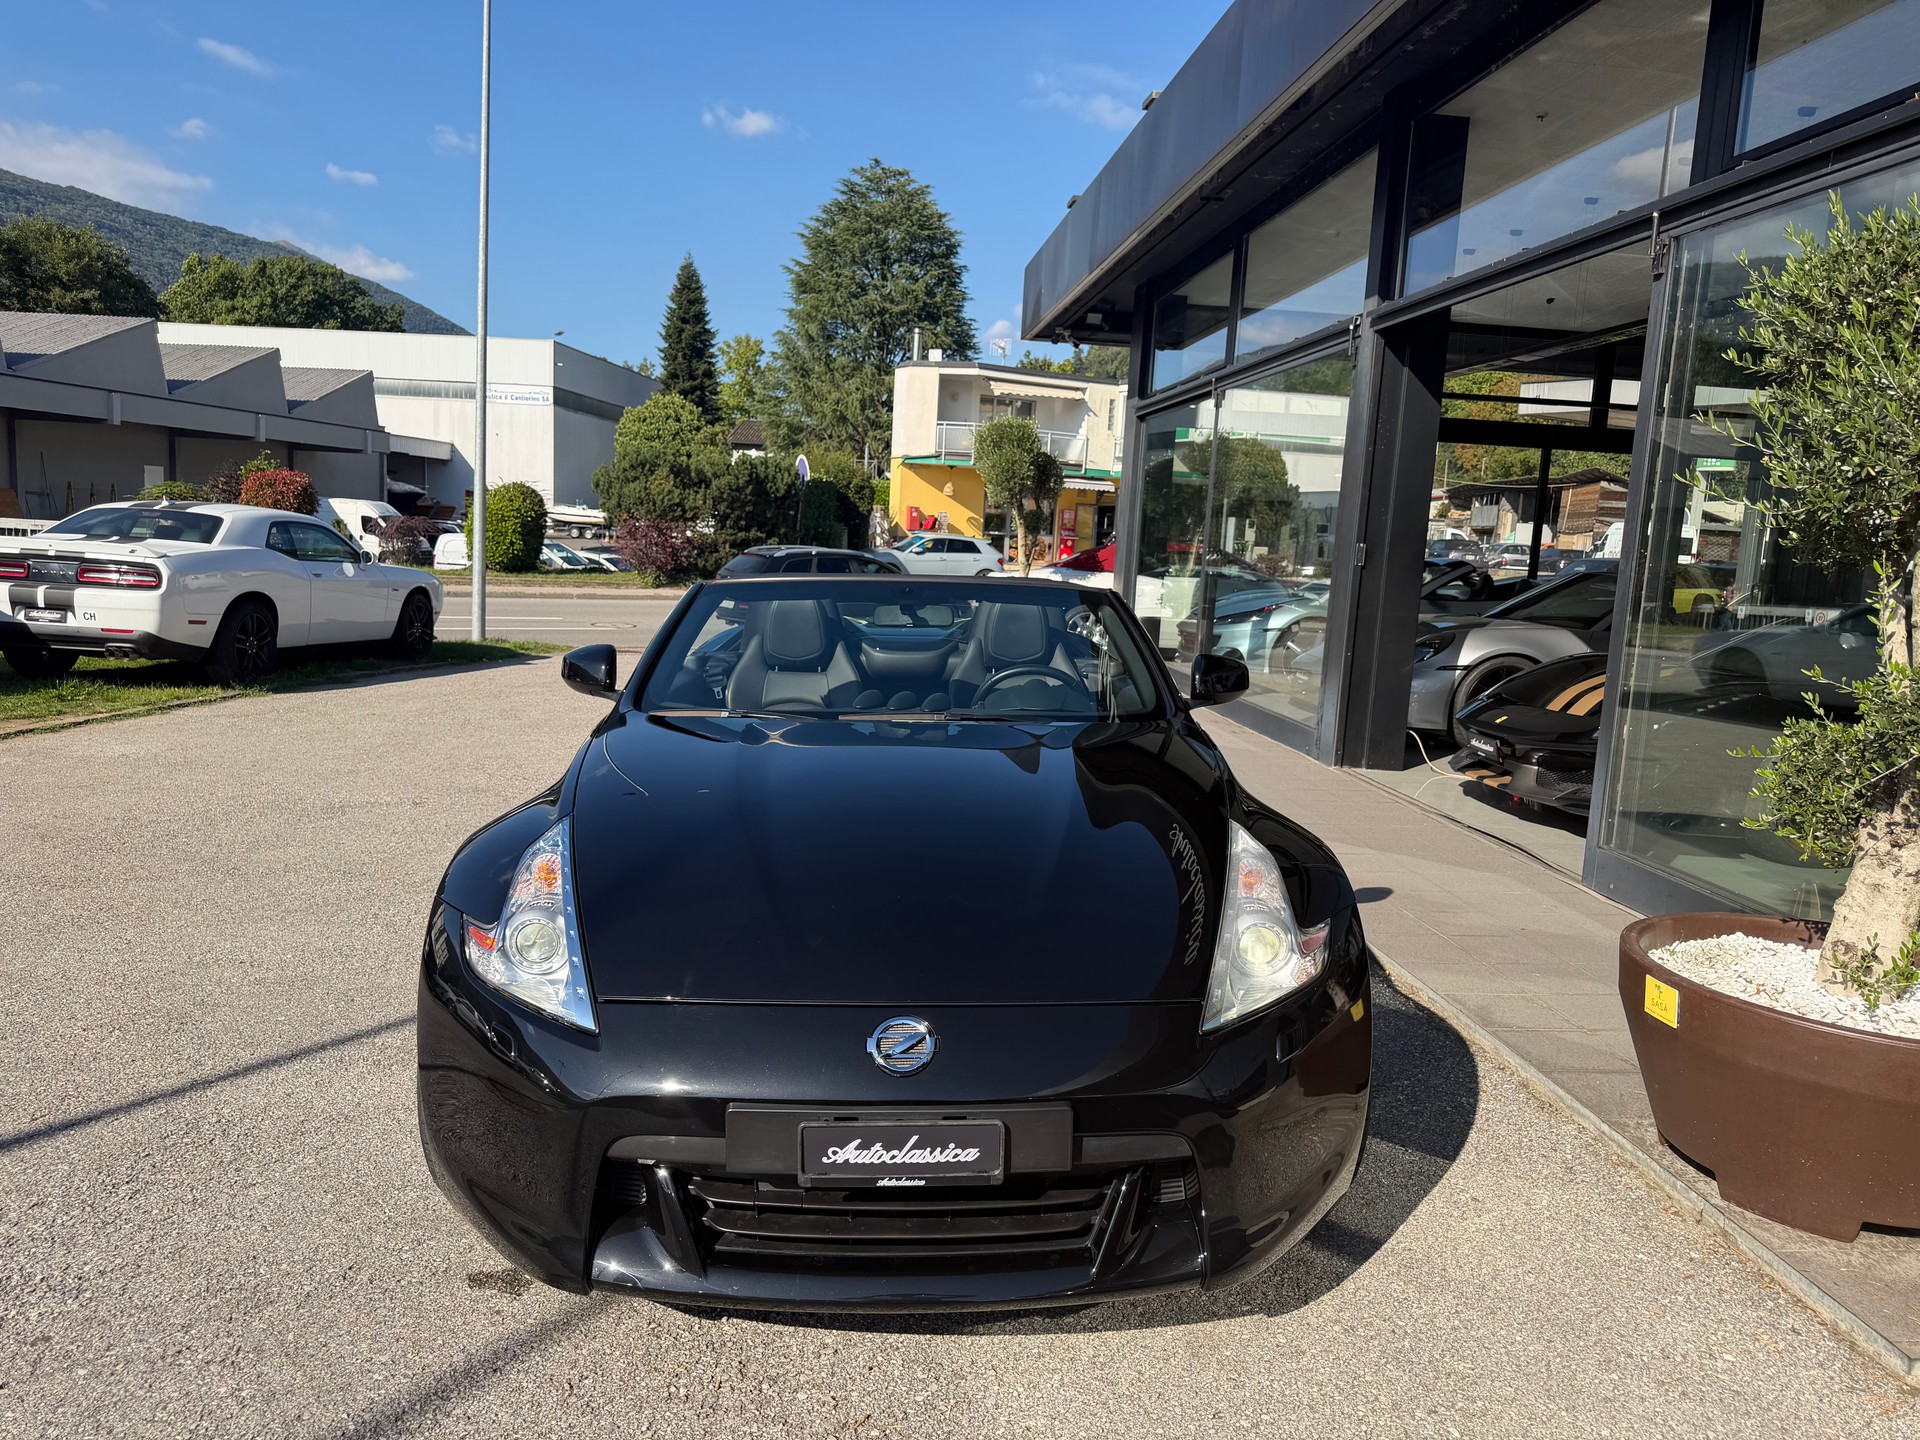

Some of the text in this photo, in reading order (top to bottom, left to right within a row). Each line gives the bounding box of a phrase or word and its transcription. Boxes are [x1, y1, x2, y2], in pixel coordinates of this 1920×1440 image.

[510, 394, 540, 402] Cantierino
[83, 612, 96, 621] CH
[822, 1135, 980, 1164] Autoclassica
[876, 1177, 926, 1187] Autoclassica
